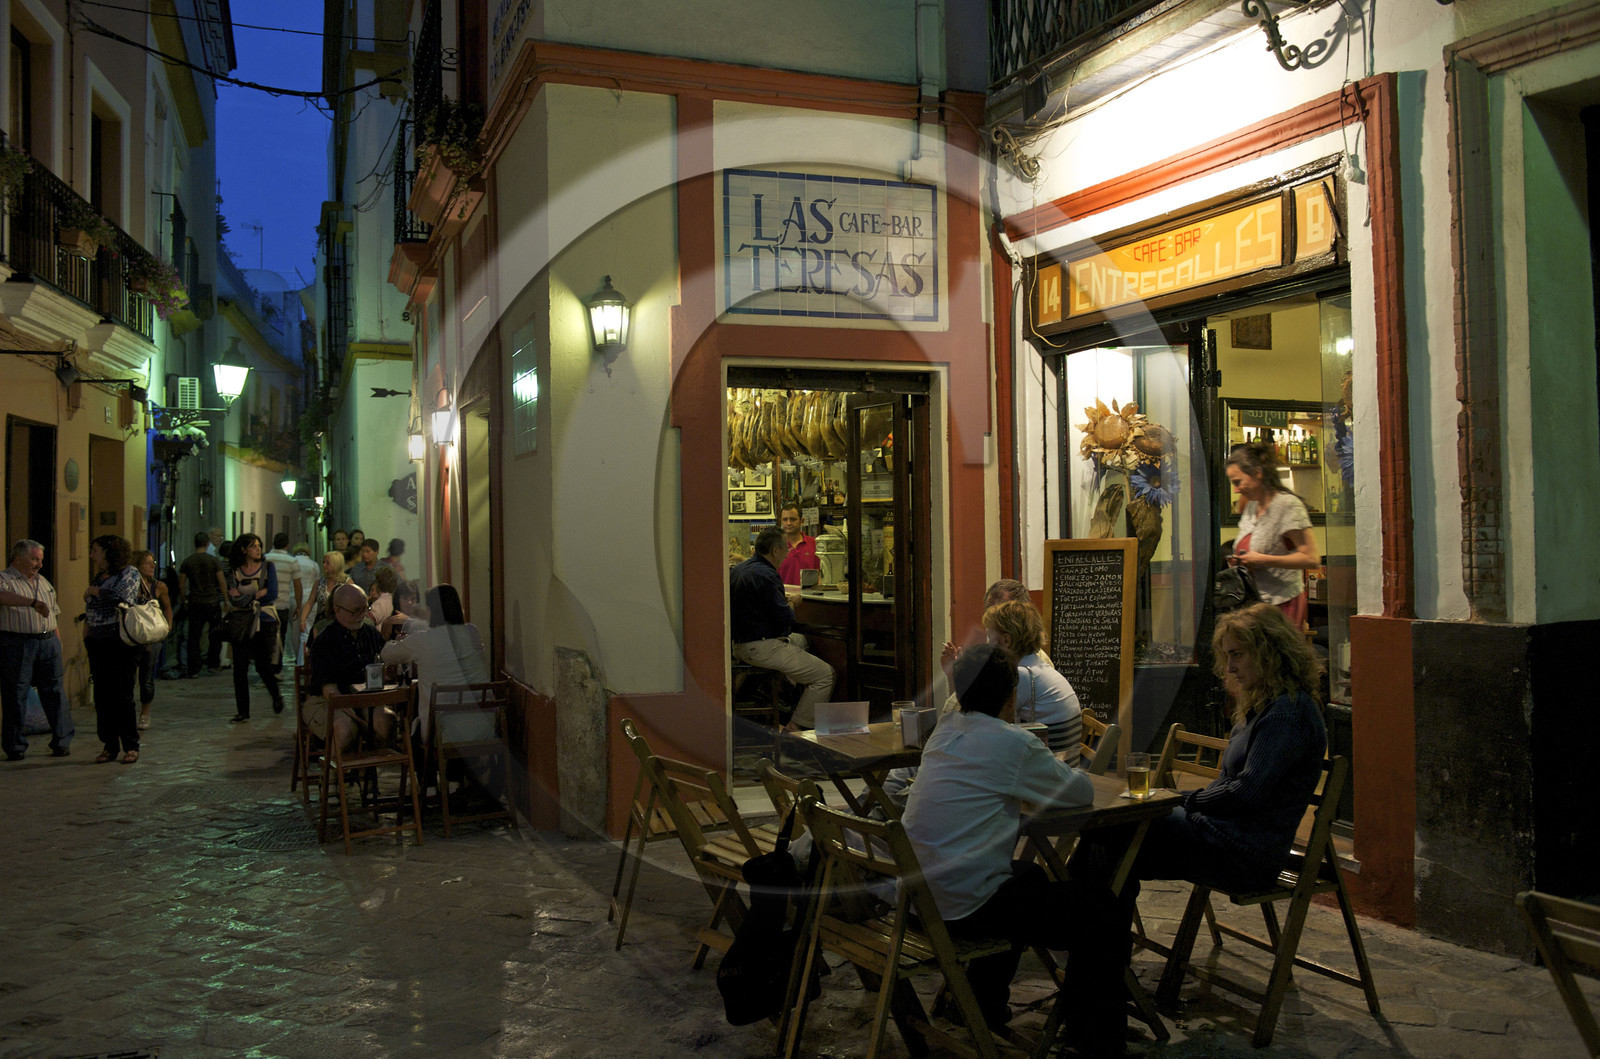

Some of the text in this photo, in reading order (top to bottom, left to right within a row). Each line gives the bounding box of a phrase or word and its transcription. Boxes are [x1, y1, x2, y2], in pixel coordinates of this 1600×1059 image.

[752, 193, 837, 246] LAS
[1075, 204, 1277, 312] ENTRECALLES
[1134, 228, 1201, 263] CAFE BAR
[738, 243, 927, 300] TERESAS
[1043, 276, 1061, 315] 14
[1058, 553, 1122, 564] ENTRECALLES
